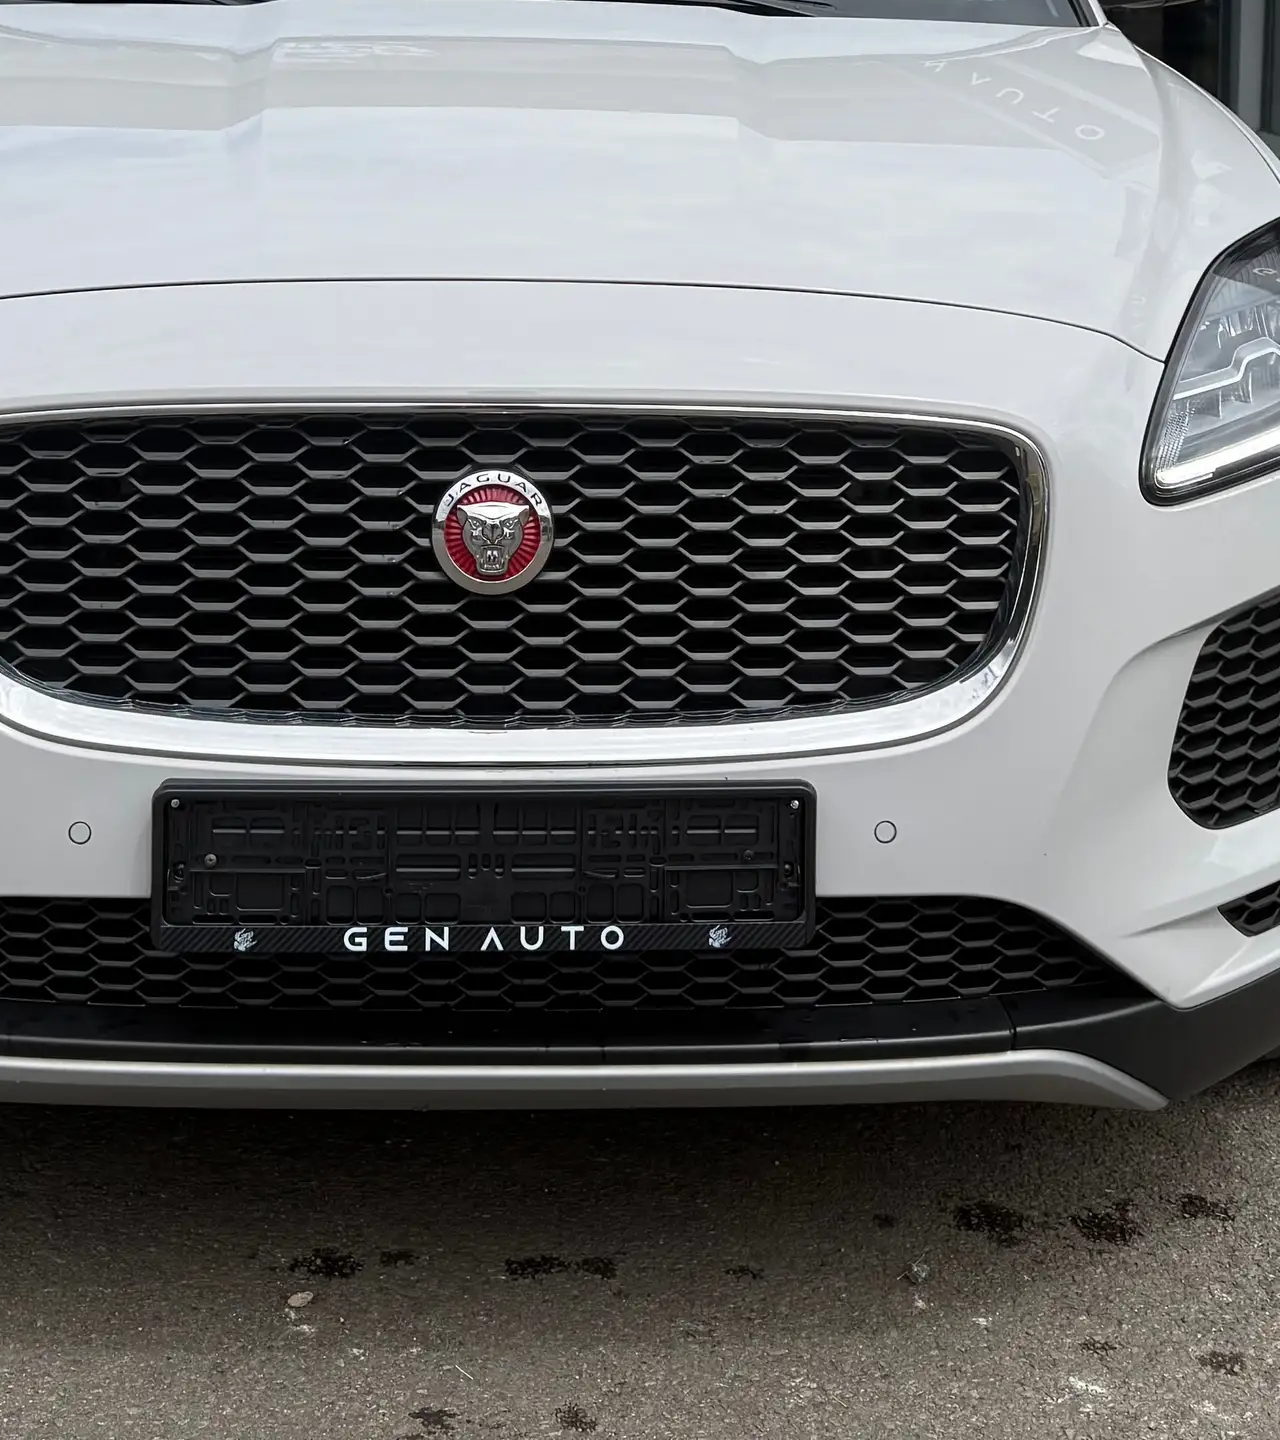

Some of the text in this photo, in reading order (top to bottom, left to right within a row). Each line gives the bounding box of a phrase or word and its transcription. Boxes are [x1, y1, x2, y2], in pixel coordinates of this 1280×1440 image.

[445, 473, 543, 507] JAGUAR
[343, 925, 624, 952] GEN AUTO
